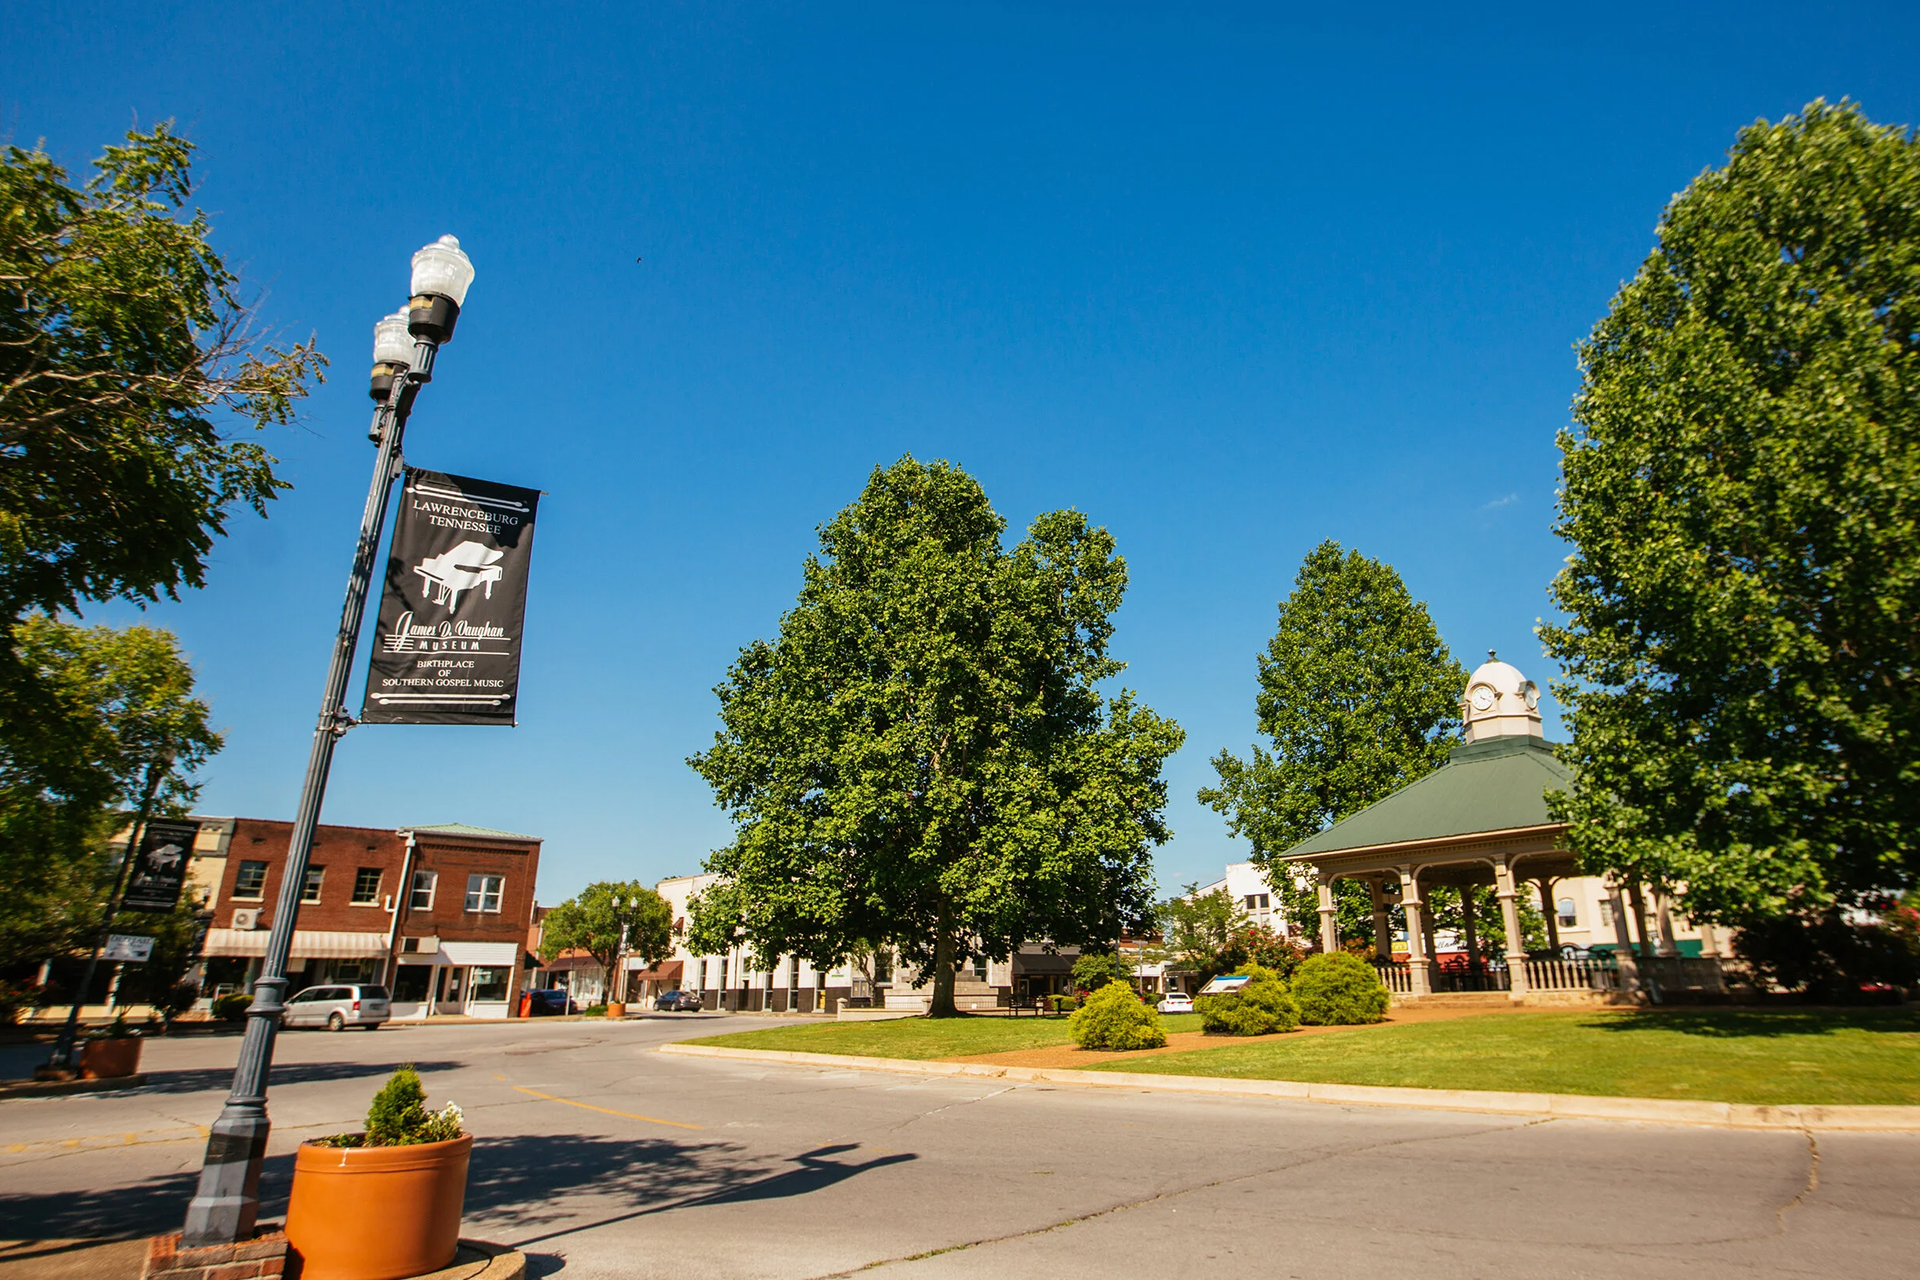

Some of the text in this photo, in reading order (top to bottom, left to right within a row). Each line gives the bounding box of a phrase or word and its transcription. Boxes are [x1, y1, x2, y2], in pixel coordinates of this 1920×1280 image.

[413, 500, 518, 526] LAWRENCEBURG
[429, 515, 501, 534] TENNESSEE
[395, 611, 504, 652] James D. Vaughan
[418, 640, 481, 651] MUSEUM
[416, 660, 475, 668] BIRTHPLACE
[438, 669, 452, 677] OF
[382, 678, 504, 687] SOUTHERN GOSPEL MUSIC
